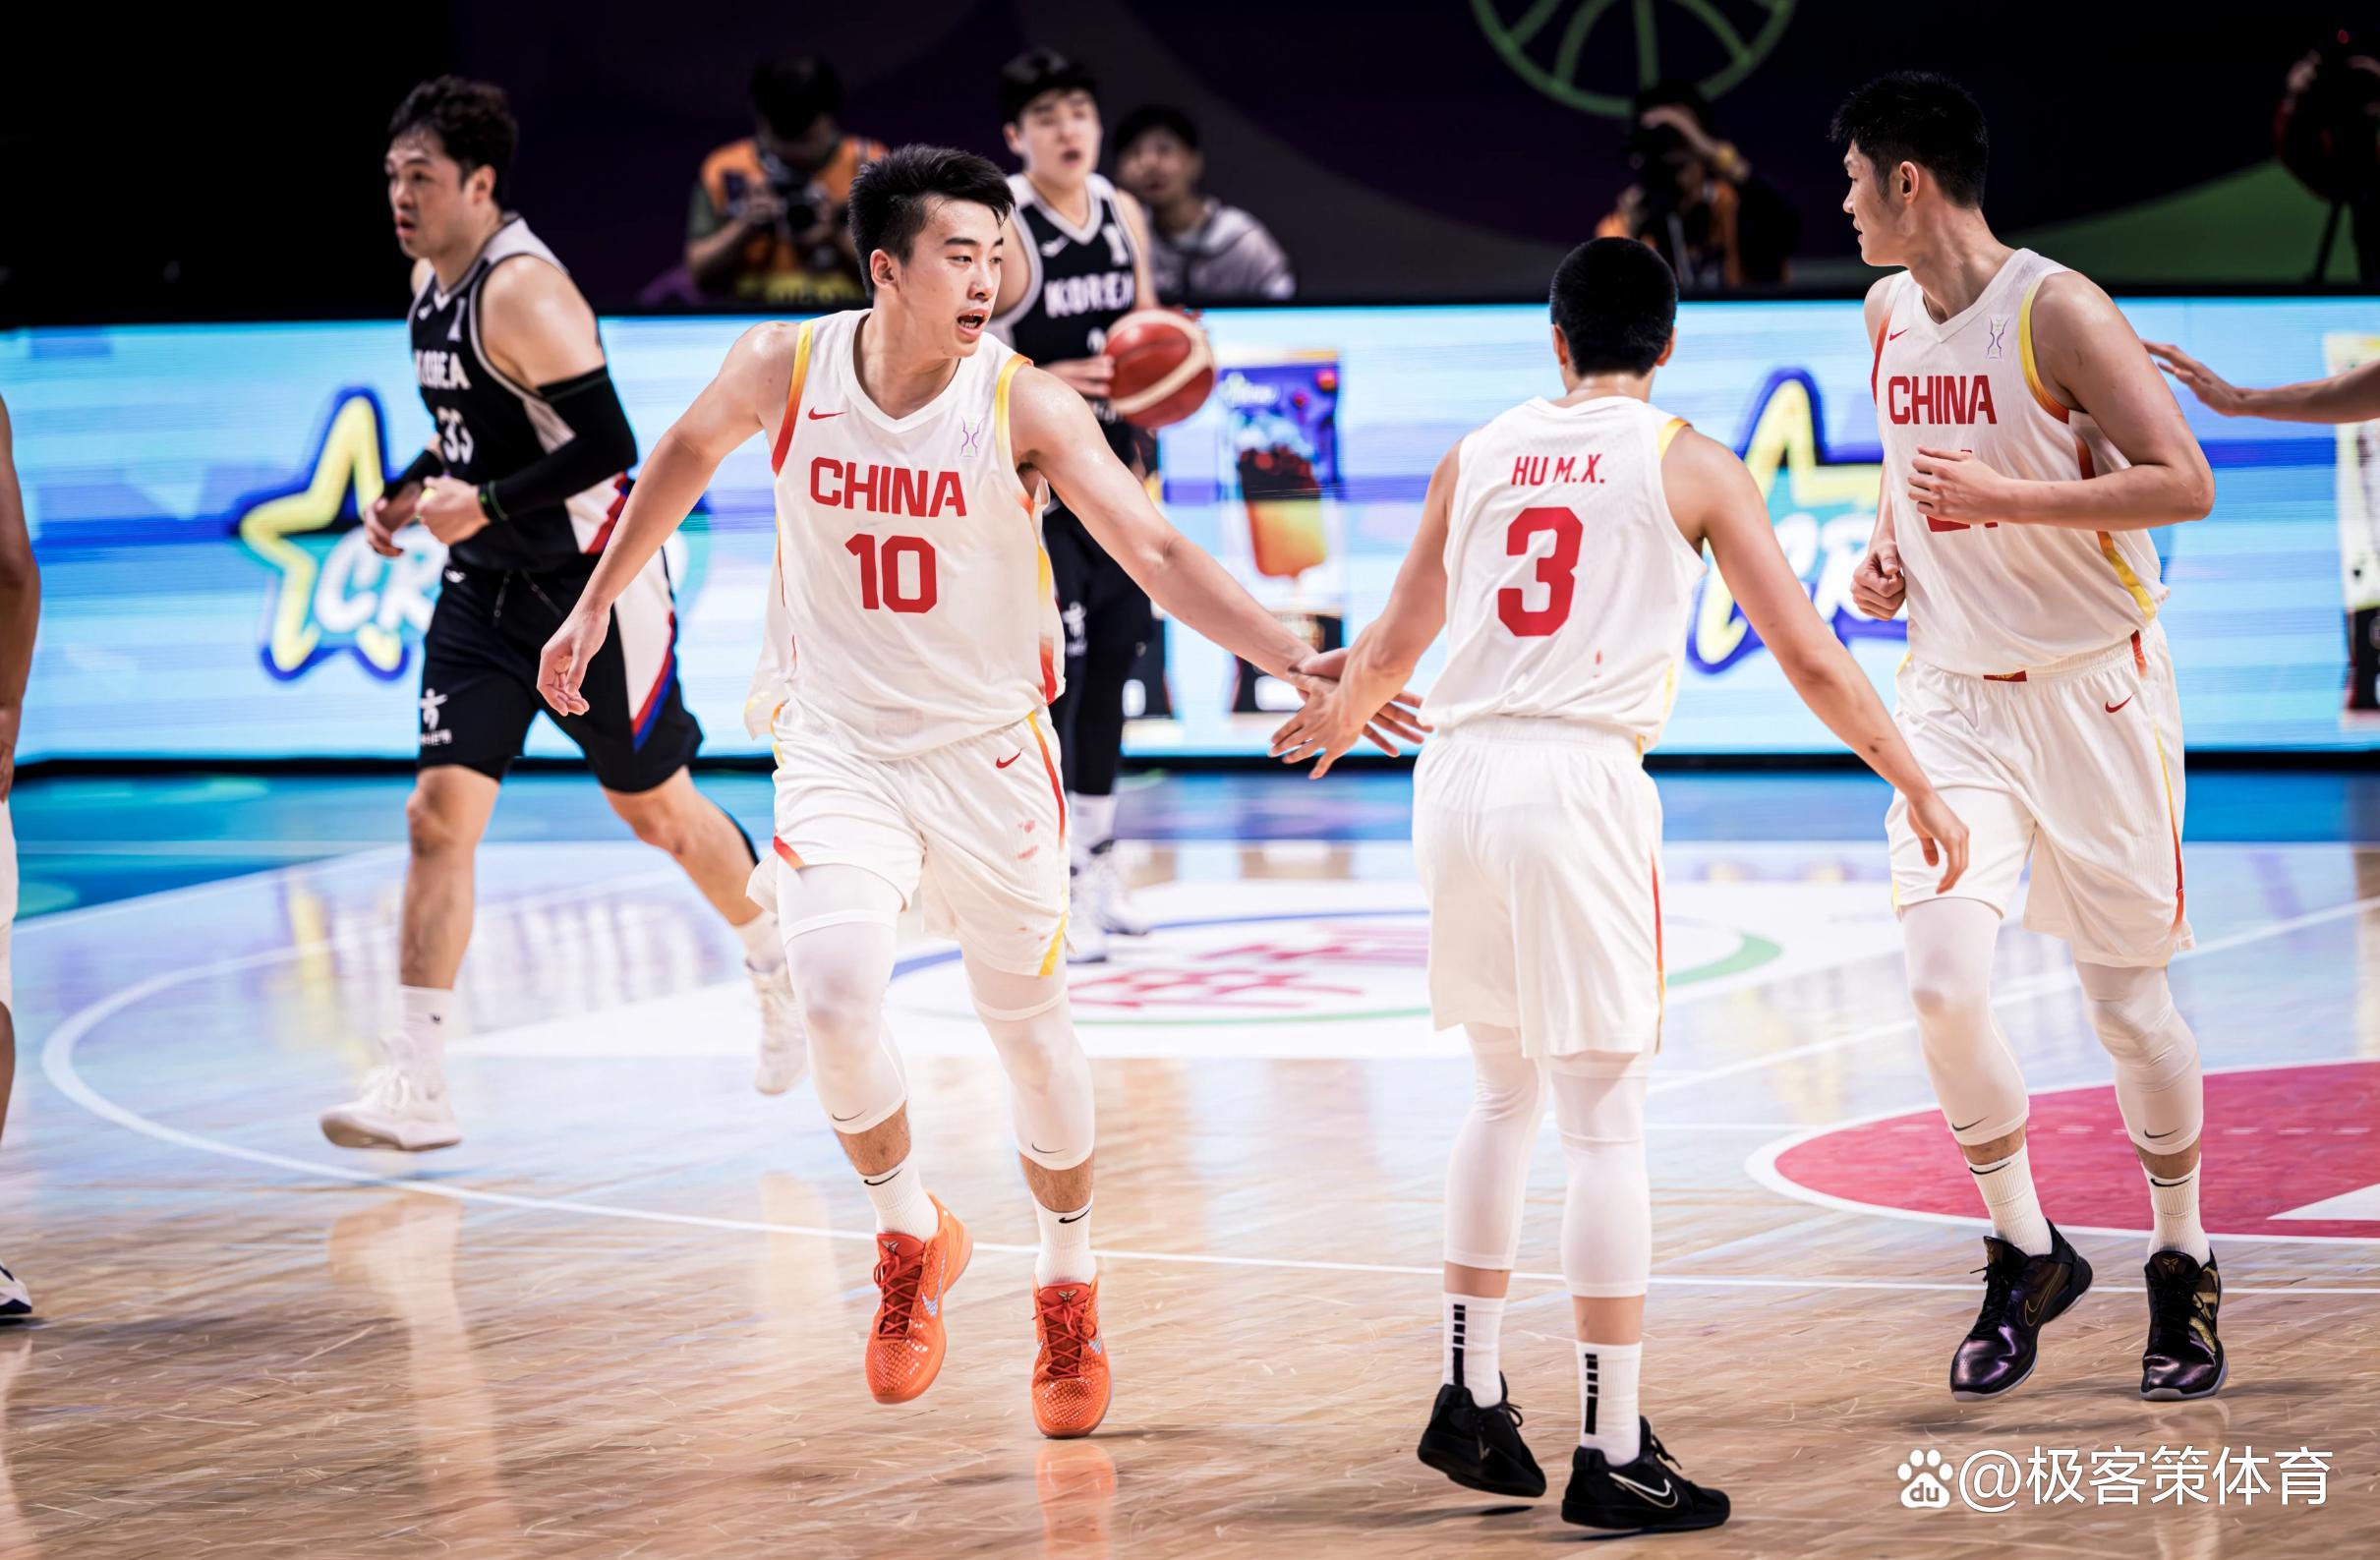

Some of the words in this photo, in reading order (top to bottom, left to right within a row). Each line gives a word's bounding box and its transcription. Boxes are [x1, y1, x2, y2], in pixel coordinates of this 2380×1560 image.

[1888, 375, 1998, 425] CHINA
[810, 456, 967, 518] CHINA
[1511, 456, 1549, 486] HU
[844, 533, 938, 614] 10
[1497, 506, 1584, 638] 3
